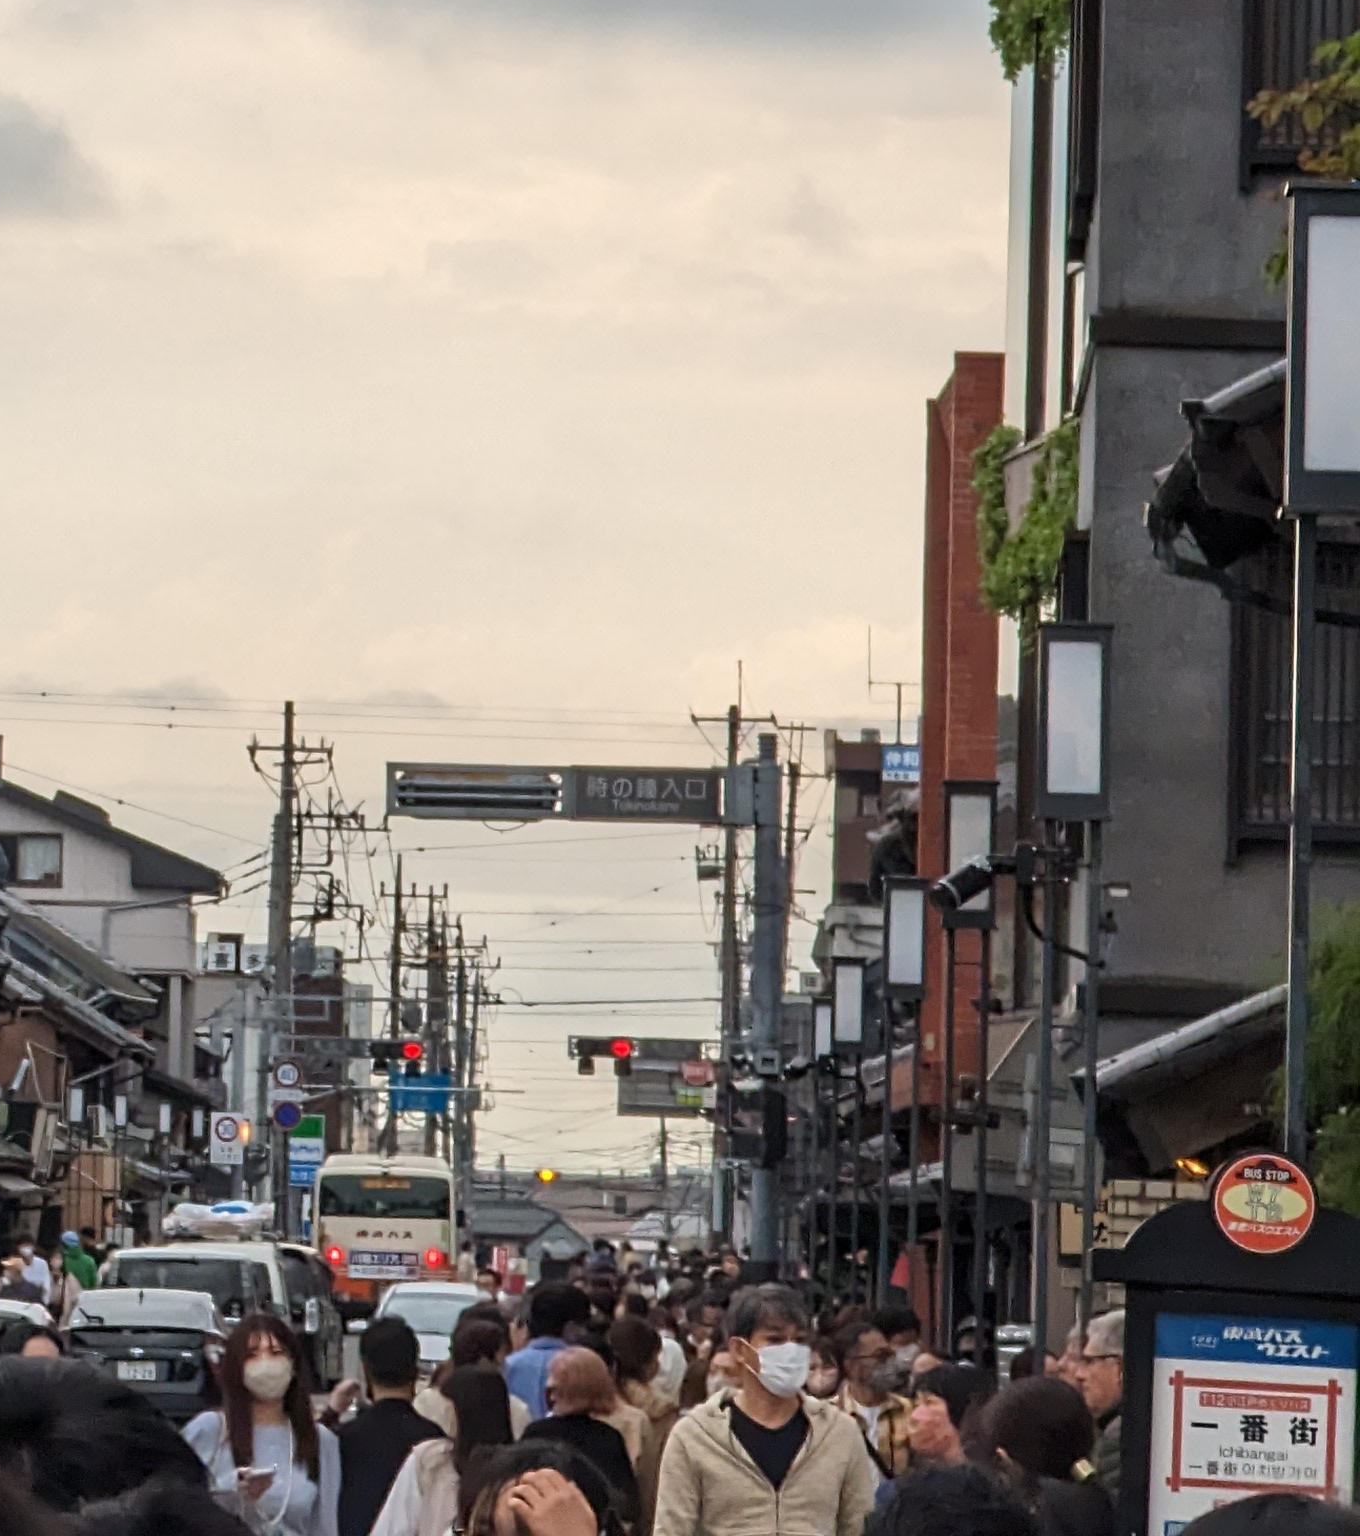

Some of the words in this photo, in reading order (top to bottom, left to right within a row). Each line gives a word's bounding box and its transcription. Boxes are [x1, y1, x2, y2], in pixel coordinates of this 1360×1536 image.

[587, 776, 707, 799] 時の鐘入口
[1243, 1168, 1262, 1179] BUS
[1265, 1170, 1289, 1181] STOP
[1256, 1343, 1330, 1360] ウエスト
[1191, 1414, 1318, 1446] 一番街
[1219, 1446, 1288, 1463] Ichibangai
